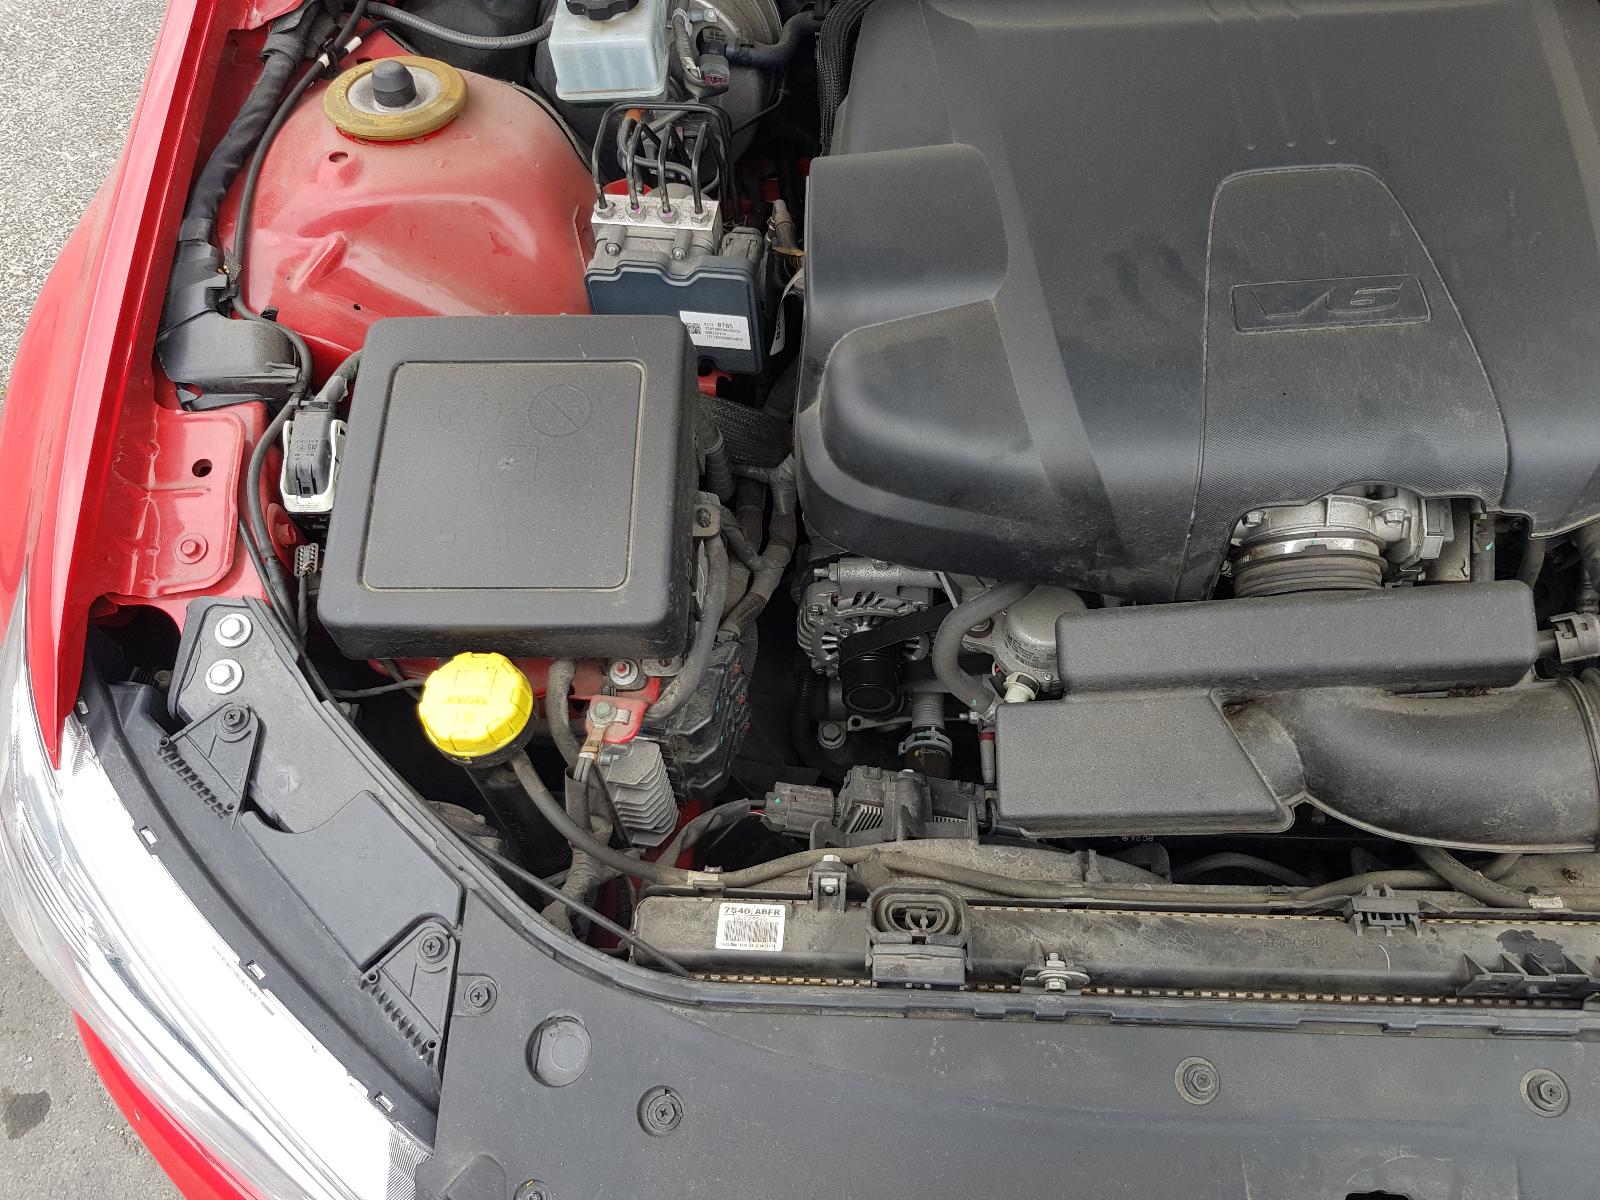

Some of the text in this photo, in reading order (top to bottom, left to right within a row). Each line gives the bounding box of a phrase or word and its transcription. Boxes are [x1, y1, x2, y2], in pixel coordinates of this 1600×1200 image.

[1250, 280, 1404, 318] V6
[724, 906, 781, 916] 7540 ABFR
